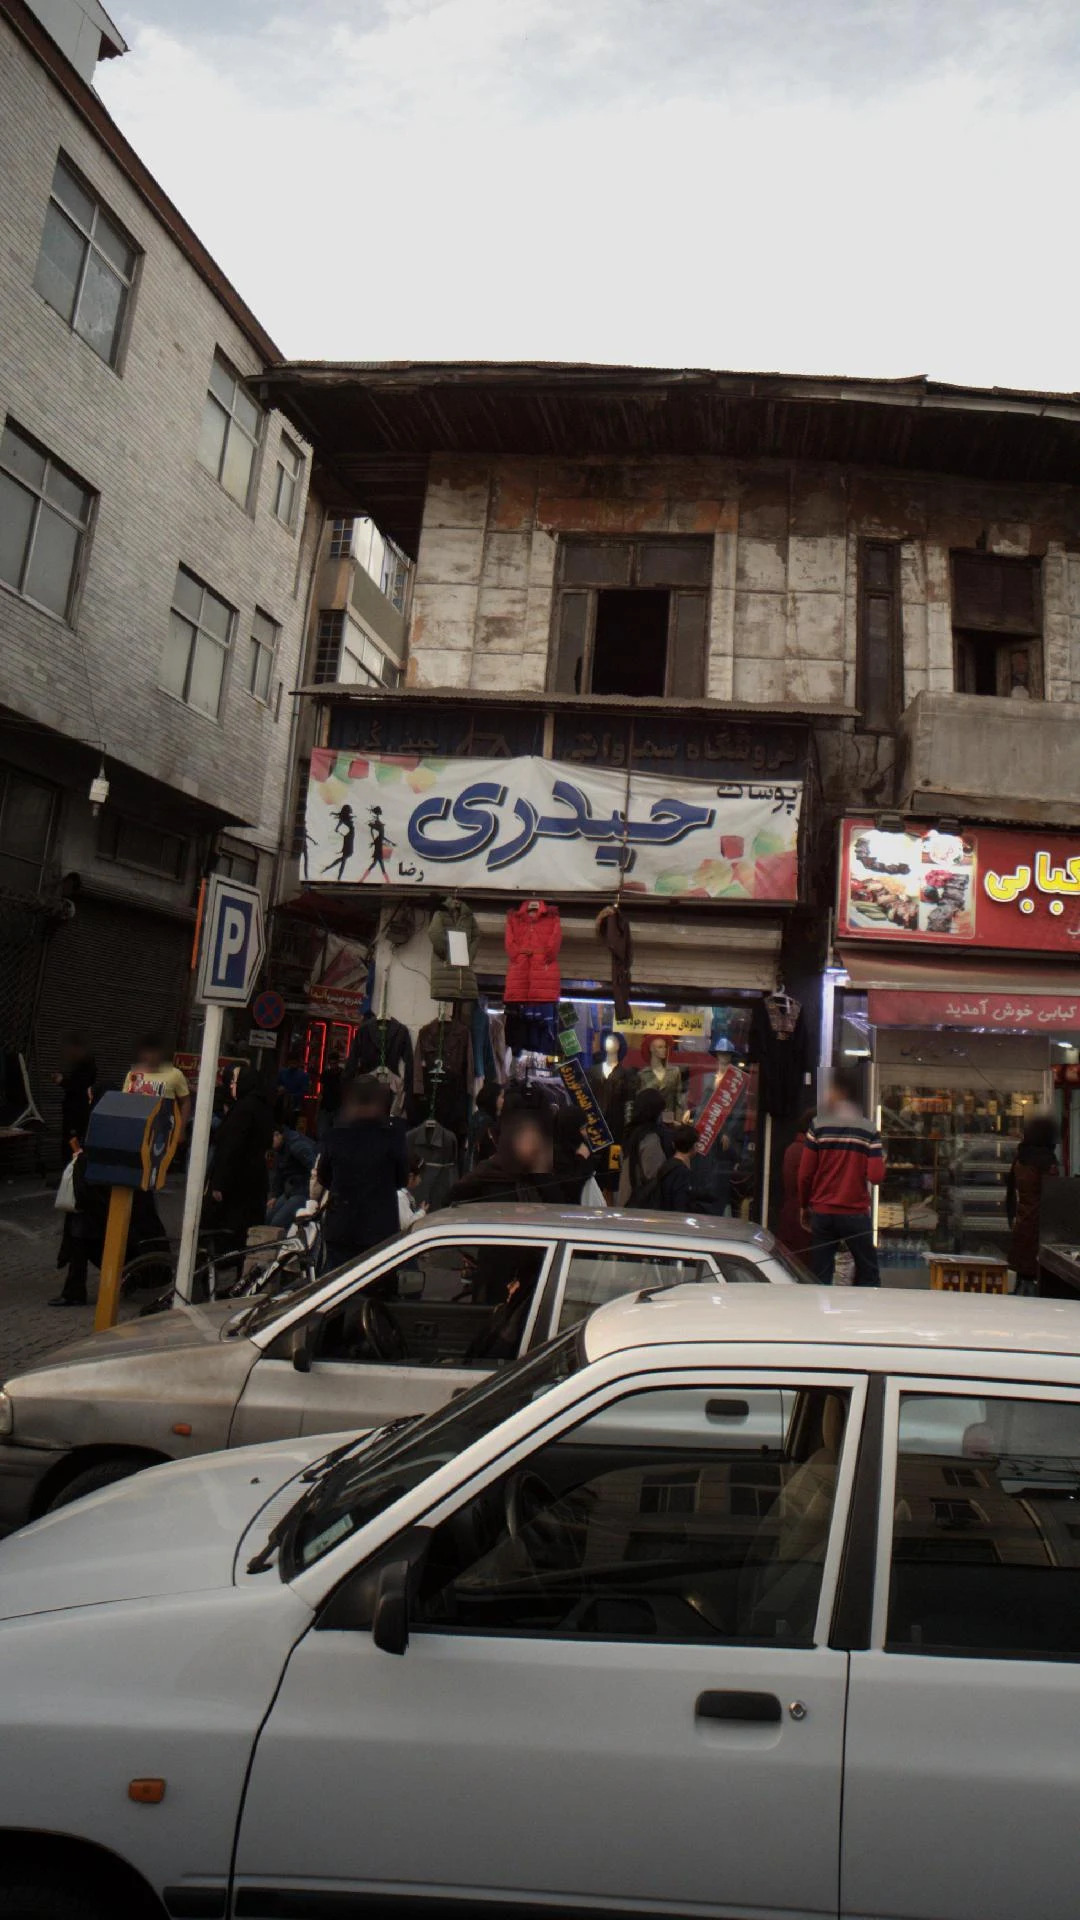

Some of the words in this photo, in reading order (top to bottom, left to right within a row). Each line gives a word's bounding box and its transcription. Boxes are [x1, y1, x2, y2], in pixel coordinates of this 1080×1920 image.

[408, 780, 717, 873] حیدری
[218, 906, 246, 981] P
[945, 998, 988, 1018] آمدید
[992, 1002, 1033, 1021] خوش
